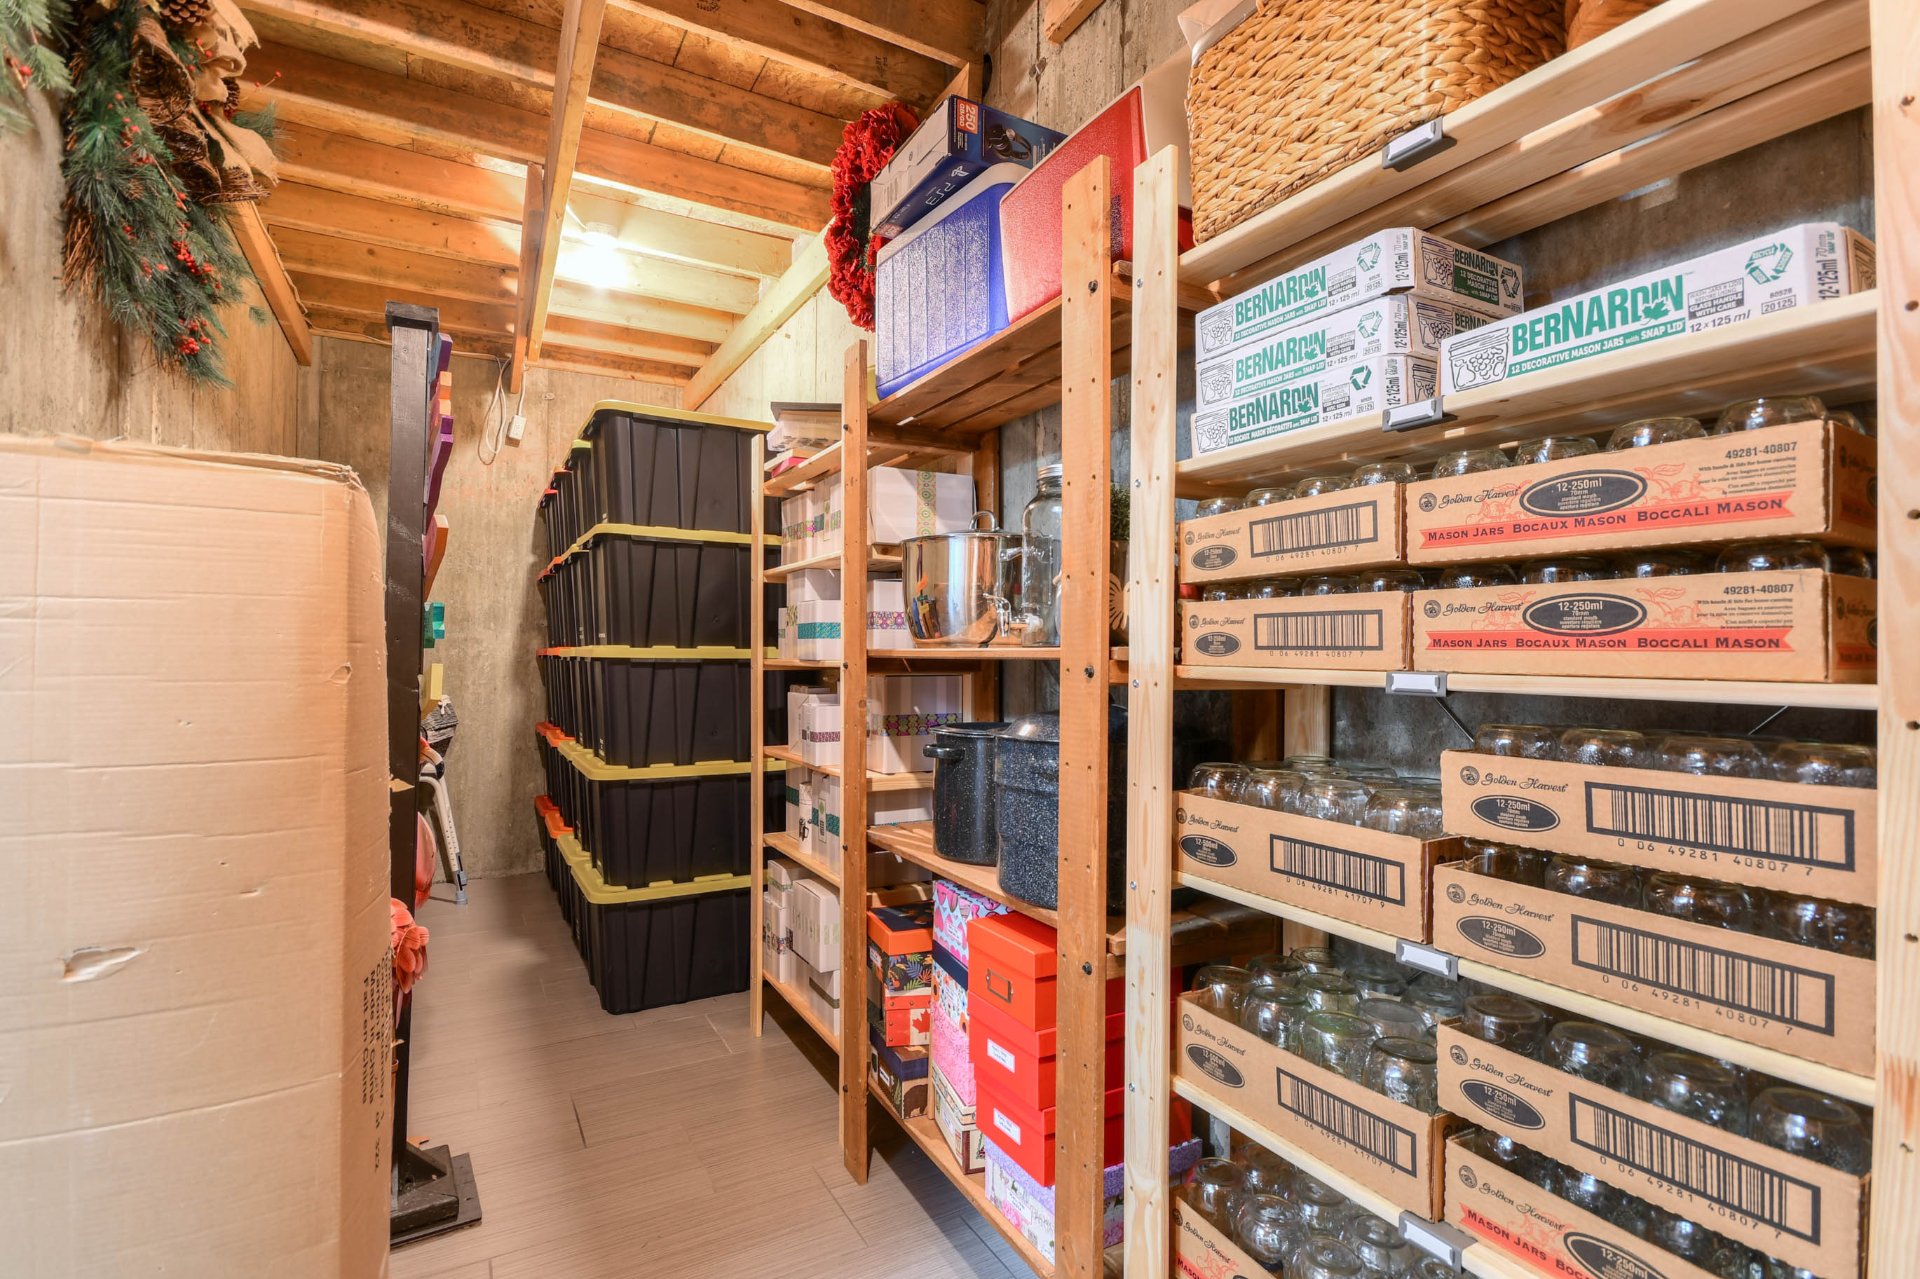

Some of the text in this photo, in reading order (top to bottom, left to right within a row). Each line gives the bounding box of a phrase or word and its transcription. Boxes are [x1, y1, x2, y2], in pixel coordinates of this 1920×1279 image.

[966, 105, 976, 131] 250
[926, 182, 956, 206] PS3
[1454, 248, 1498, 276] BERNARDIN
[1235, 265, 1326, 326] BERNARDIN
[1328, 290, 1360, 306] 12 125 ml
[1689, 280, 1742, 298] WASH JARS LIDS
[1695, 288, 1736, 303] BEFORE USING
[1690, 292, 1743, 312] GLASS HANDLE
[1695, 302, 1737, 318] WITH CARE
[1512, 274, 1683, 356] BERNARDIN
[1690, 320, 1702, 333] 12
[1712, 315, 1731, 328] 125
[1733, 310, 1751, 323] ml
[1236, 329, 1326, 382] BERNARDIN
[1327, 352, 1358, 367] 12 125 ml
[1512, 322, 1683, 374] 12 DECORATIVE MASON JARS with SNAP LID
[1229, 382, 1319, 431] BERNARDIN
[1332, 410, 1343, 419] 125
[1725, 441, 1798, 459] 49281-40807
[1556, 477, 1602, 492] 12-250ml
[1438, 486, 1521, 509] Golden Harvest
[1428, 499, 1782, 541] MASON JARS BOCAUX MASON BOCCALI MASON
[1723, 584, 1794, 595] 49281-40807
[1443, 601, 1524, 616] Golden Harvest
[1558, 600, 1603, 611] 12-250ml
[1433, 637, 1780, 649] MASON JARS BOCAUX MASON BOCCALI MASON
[1481, 772, 1568, 793] Golden Harvest
[1496, 799, 1530, 811] 12-250ml
[1188, 814, 1209, 826] Golden
[1618, 838, 1813, 876] 0 06 49281 40807 7
[1297, 879, 1306, 887] 06
[1312, 883, 1338, 897] 49281
[1345, 891, 1373, 904] 41707
[1467, 893, 1554, 922] Golden Harvest
[1482, 921, 1516, 936] 12-250ml
[1602, 975, 1793, 1036] 0 06 49281 40807 7
[1469, 1058, 1553, 1097] Golden Harvest
[1484, 1086, 1517, 1106] 12-250ml
[1354, 1148, 1383, 1168] 41707
[1391, 1167, 1396, 1175] 9
[1479, 1183, 1565, 1231] Golden Harvest
[1600, 1156, 1782, 1240] 0 06 49281 40807 7
[1468, 1210, 1510, 1241] MASON
[1514, 1236, 1548, 1261] JARS
[1601, 1248, 1648, 1278] 12-250ml
